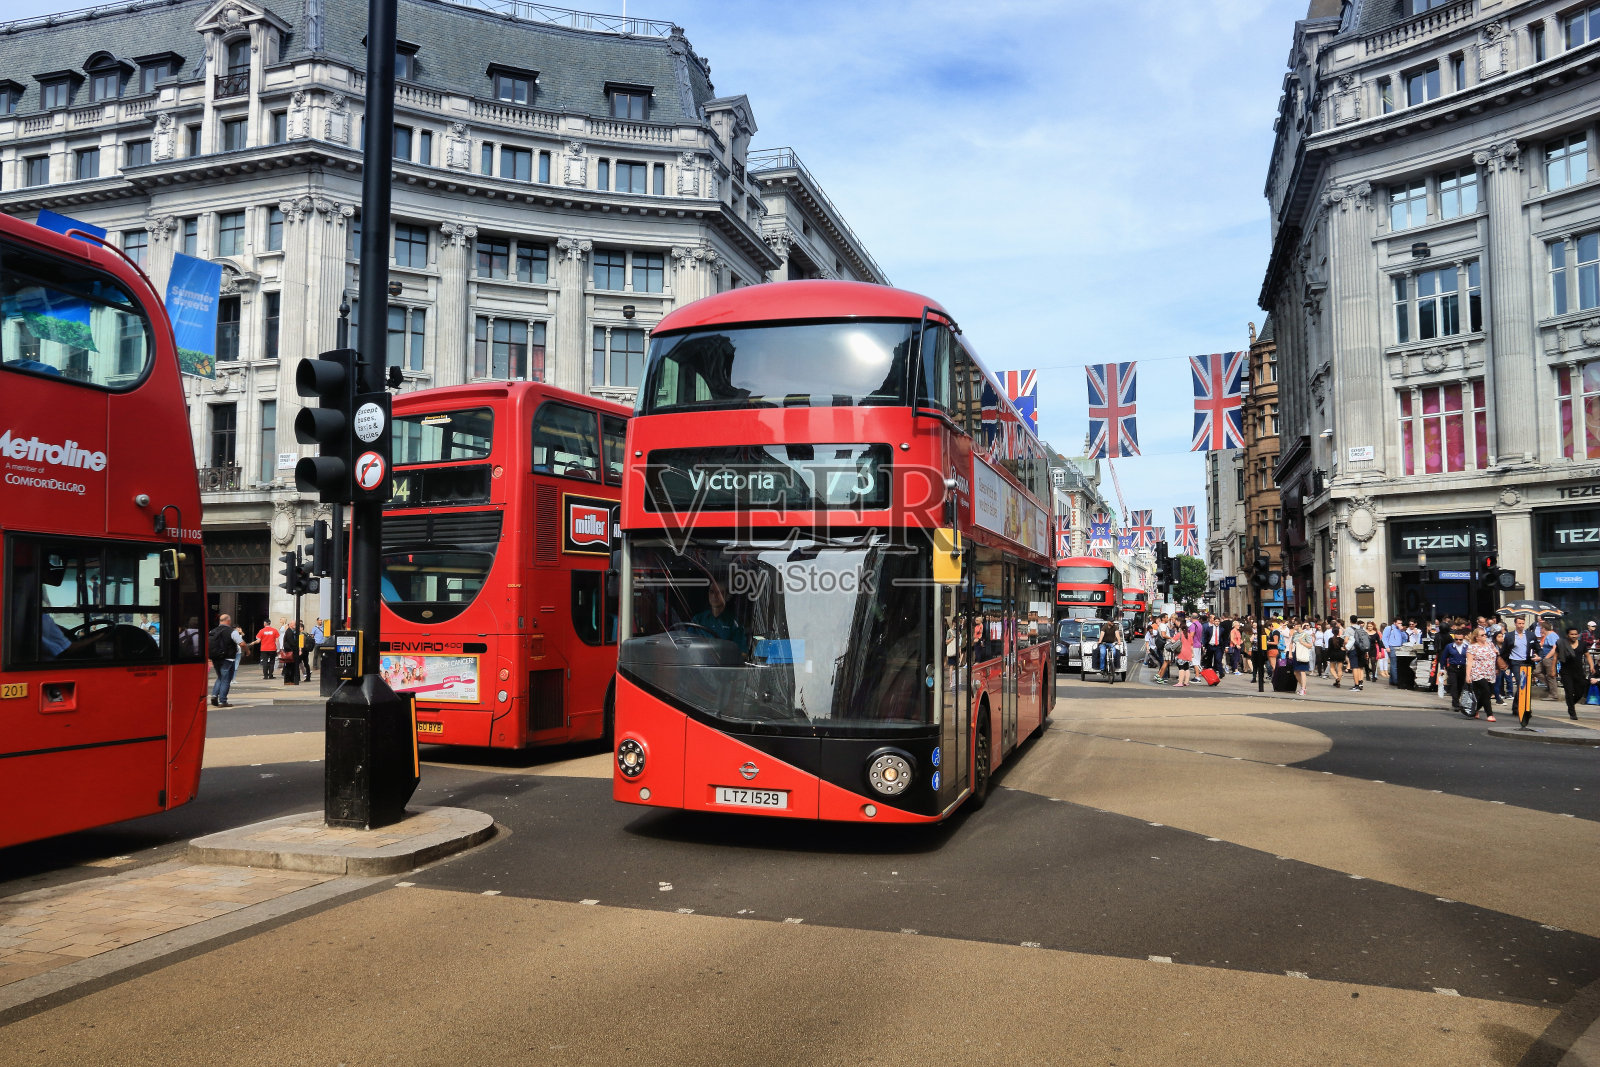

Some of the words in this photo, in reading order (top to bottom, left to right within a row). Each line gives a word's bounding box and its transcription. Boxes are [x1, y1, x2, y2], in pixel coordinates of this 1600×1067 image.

[171, 285, 214, 304] Summer
[360, 431, 379, 441] cycles
[12, 464, 37, 472] member
[688, 468, 775, 491] Victoria
[575, 513, 606, 536] müller
[1403, 532, 1488, 550] TEZENS
[1093, 593, 1101, 601] 10
[391, 641, 443, 652] ENVIRO
[4, 685, 23, 697] 201
[723, 789, 748, 803] LTZ
[751, 791, 779, 805] 1529
